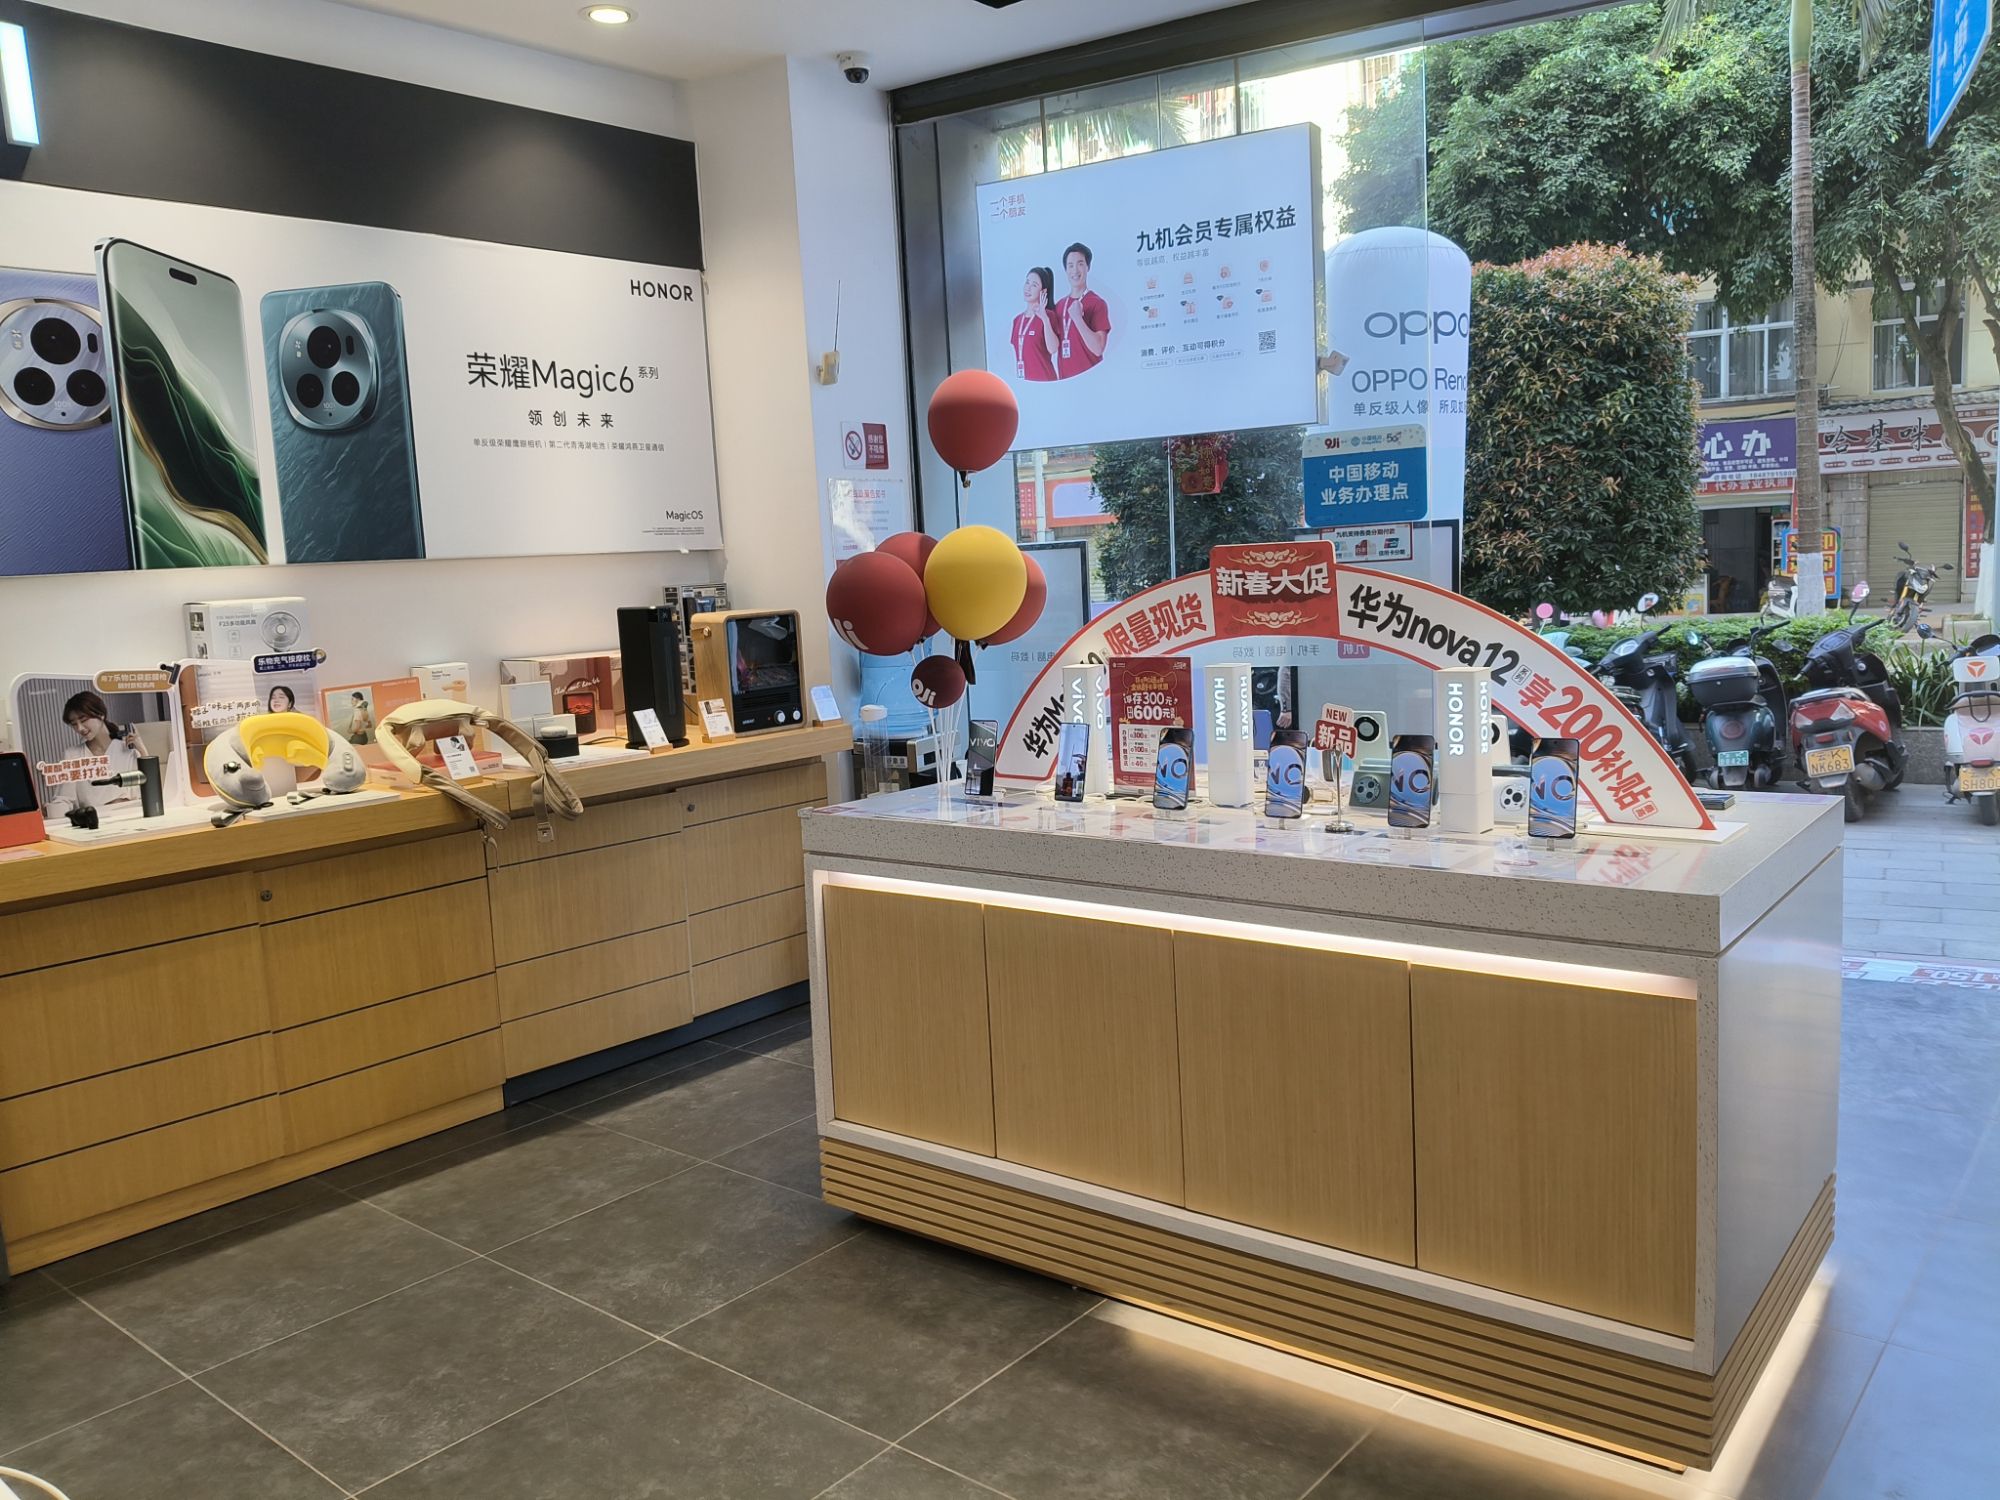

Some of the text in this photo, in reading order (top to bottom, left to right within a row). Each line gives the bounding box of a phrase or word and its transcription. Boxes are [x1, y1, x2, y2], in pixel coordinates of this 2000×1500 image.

[1136, 205, 1297, 252] 九机会员专属权益
[630, 279, 694, 301] HONOR
[466, 351, 660, 399] 荣耀Magic6 系列
[1351, 368, 1428, 393] OPPO
[1353, 399, 1429, 417] 单反级人像
[1328, 460, 1400, 484] 中国移动
[1320, 482, 1409, 506] 业务办理点
[665, 510, 704, 522] MagicOS
[1216, 562, 1332, 597] 新春大促
[1103, 592, 1207, 656] 限量现货
[1095, 675, 1104, 730] vivo
[1213, 677, 1227, 742] HUAWEI
[1239, 675, 1249, 741] HUAWEI
[1326, 708, 1348, 723] NEW
[1447, 682, 1464, 756] HONOR
[1479, 681, 1489, 754] HONOR
[1318, 723, 1353, 756] 新品
[1811, 760, 1850, 774] NK683
